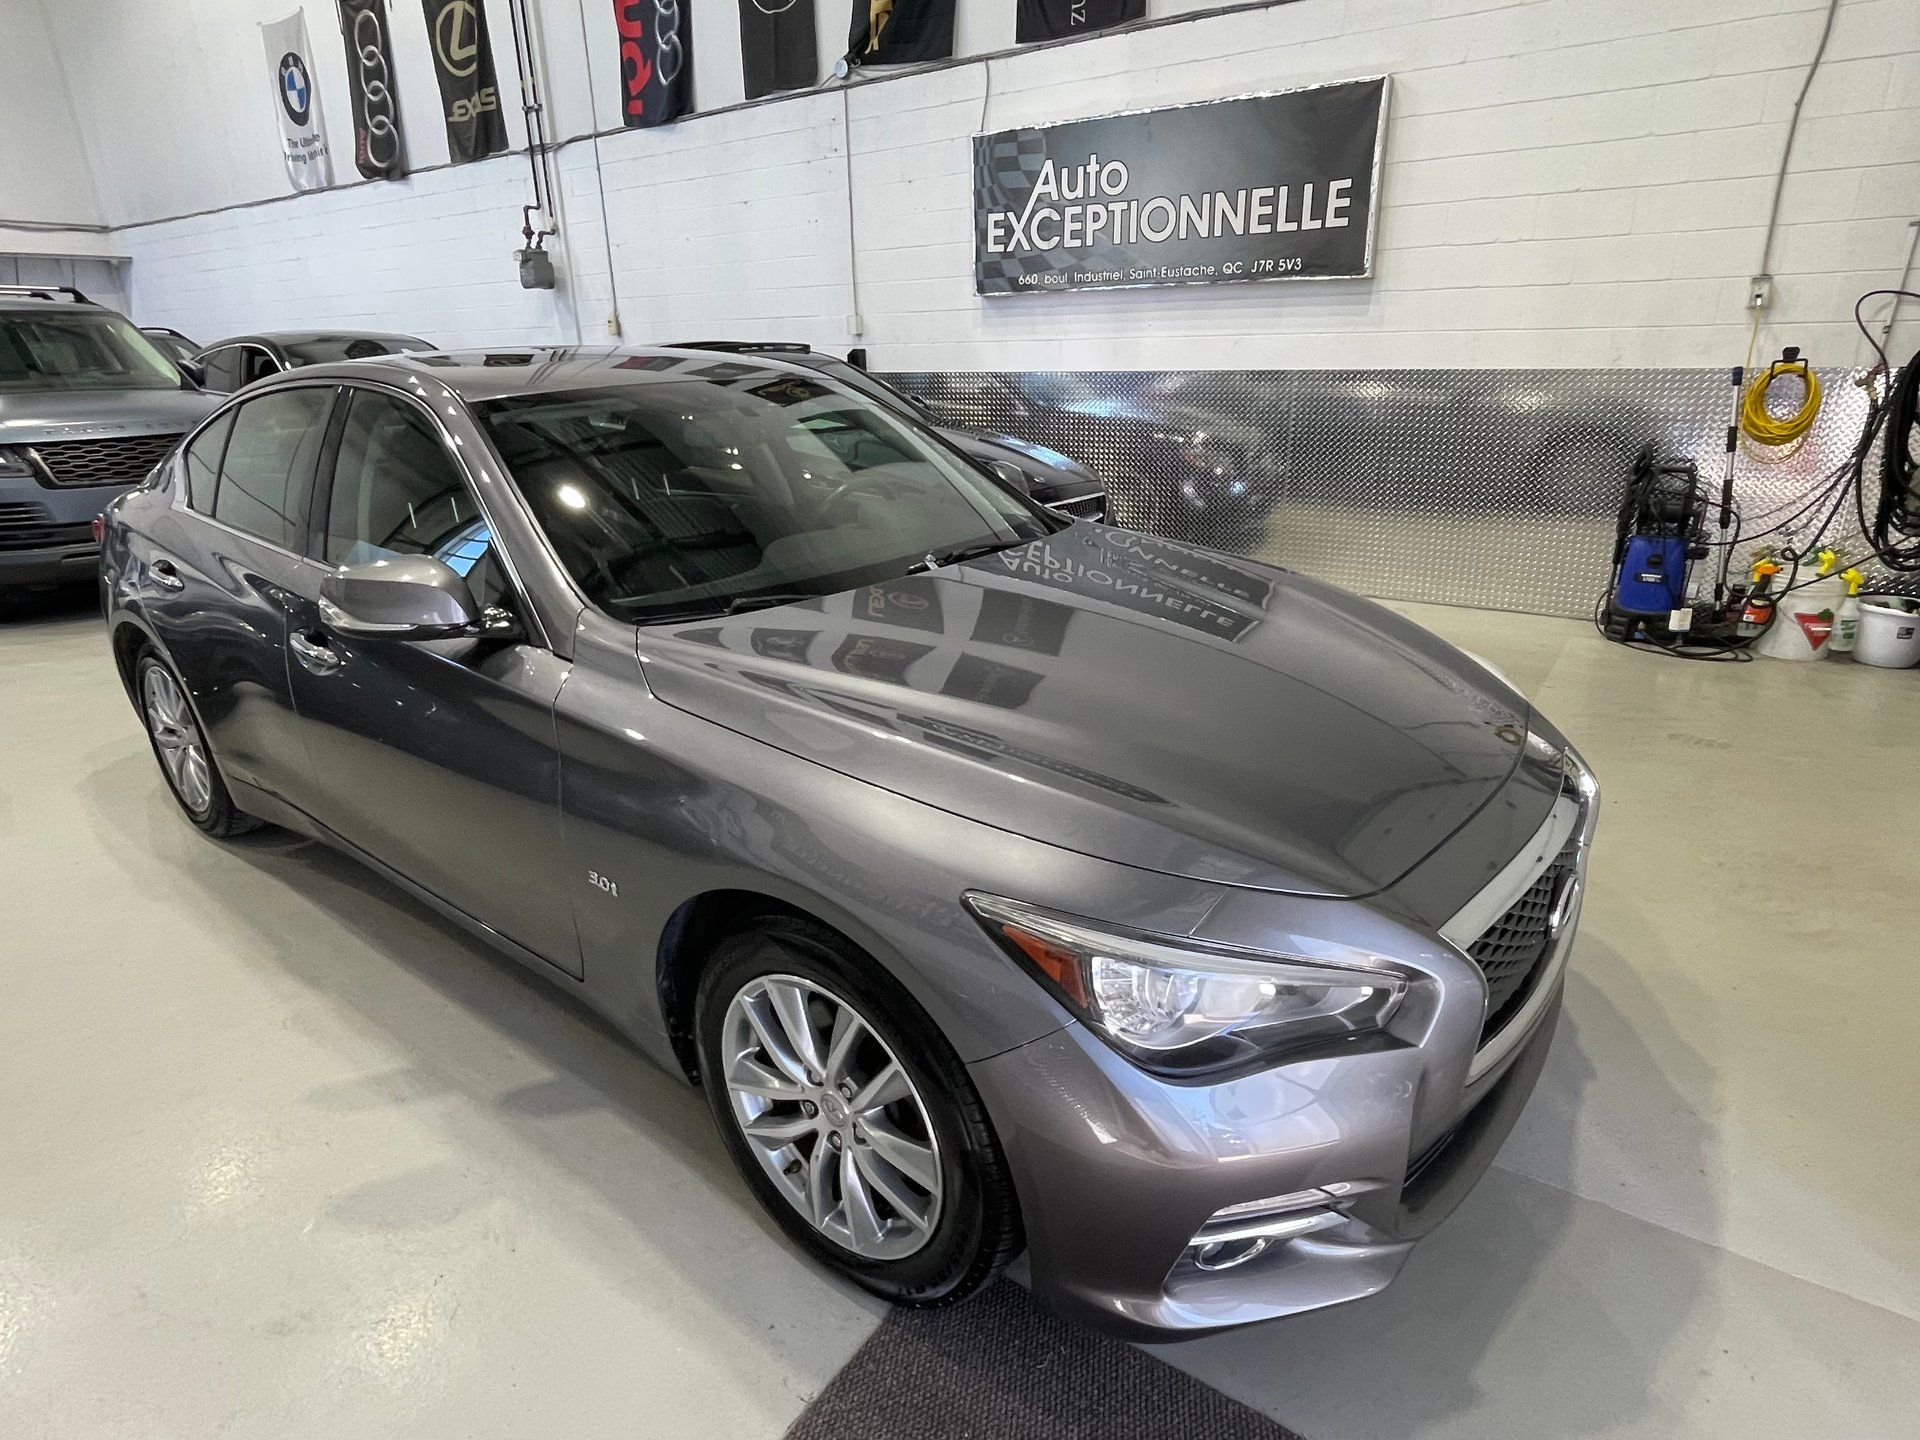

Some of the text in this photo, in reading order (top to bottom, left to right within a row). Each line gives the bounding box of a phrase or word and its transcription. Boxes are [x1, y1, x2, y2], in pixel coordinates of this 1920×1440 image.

[1031, 153, 1130, 202] Auto
[986, 178, 1353, 254] EXCEPTIONNELLE
[1129, 264, 1218, 280] Saint-Eustache,
[1222, 260, 1243, 275] QC
[1251, 257, 1274, 273] J7R
[1278, 257, 1302, 272] 5V3
